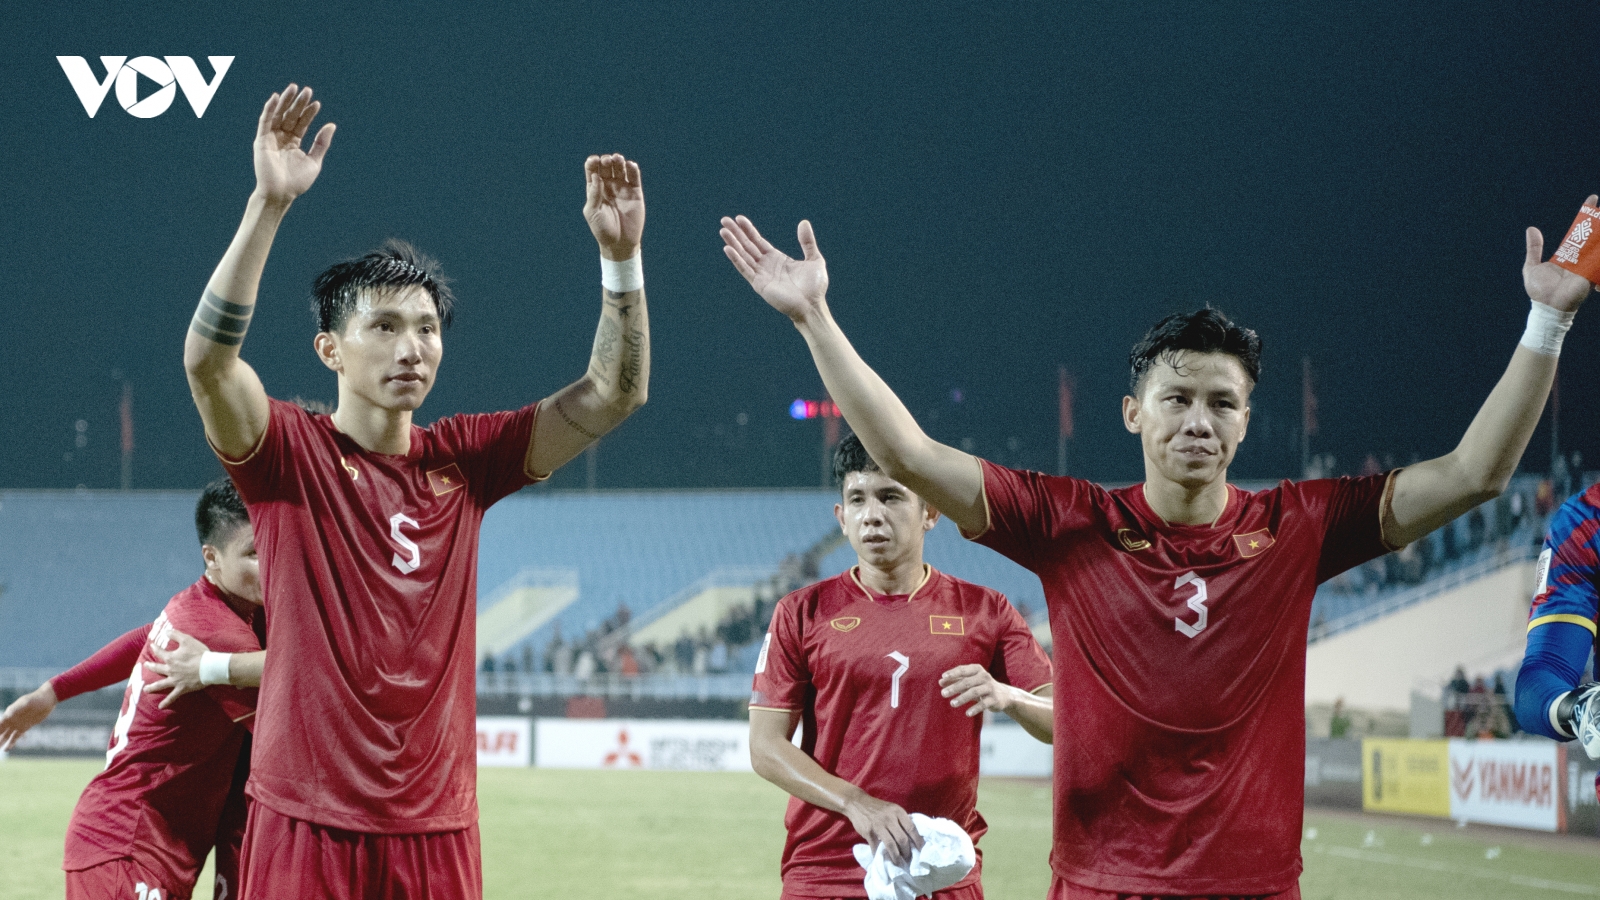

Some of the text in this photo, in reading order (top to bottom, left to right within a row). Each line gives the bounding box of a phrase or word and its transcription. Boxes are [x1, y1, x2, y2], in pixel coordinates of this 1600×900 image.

[389, 512, 420, 575] 5
[1173, 570, 1208, 639] 3
[883, 650, 910, 709] 7
[1479, 760, 1552, 808] YANMAR
